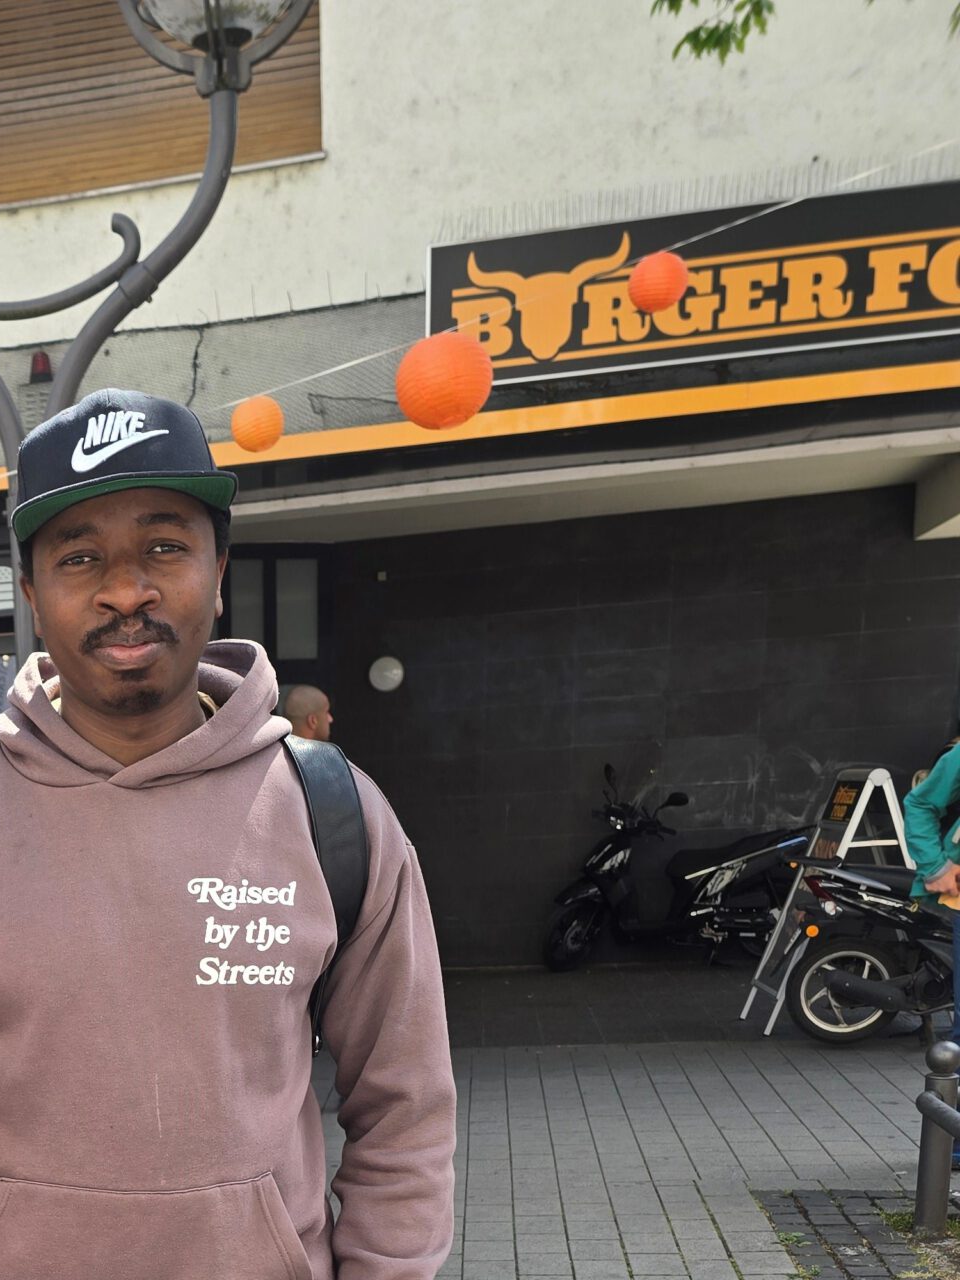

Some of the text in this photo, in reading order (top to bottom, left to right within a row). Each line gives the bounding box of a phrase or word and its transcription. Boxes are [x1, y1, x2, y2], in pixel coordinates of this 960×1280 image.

[84, 410, 146, 450] NIKE
[187, 877, 297, 911] Raised
[204, 916, 291, 951] by the
[195, 956, 295, 985] Streets
